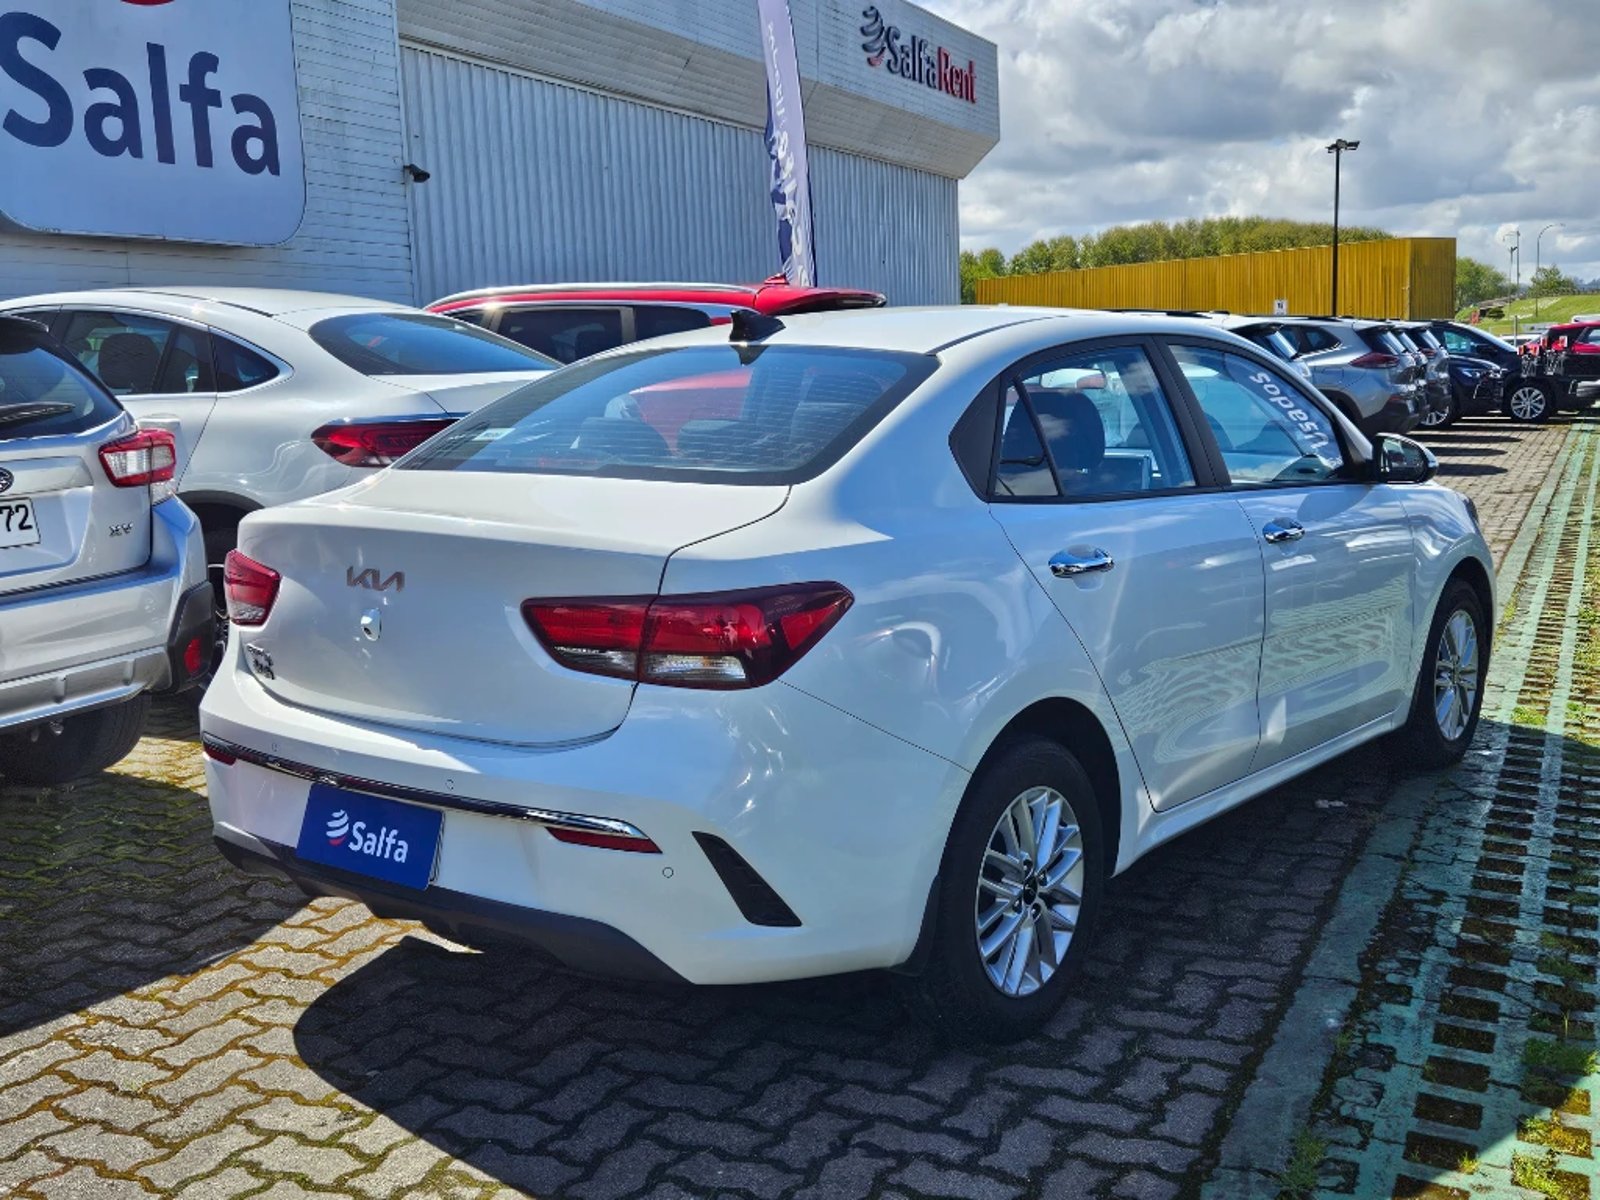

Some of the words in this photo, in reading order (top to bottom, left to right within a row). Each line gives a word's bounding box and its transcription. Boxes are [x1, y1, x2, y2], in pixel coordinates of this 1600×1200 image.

[886, 25, 977, 104] SalfaRent
[0, 11, 281, 177] Salfa
[1250, 371, 1329, 450] Usados
[0, 504, 33, 532] 72
[109, 522, 134, 537] XV
[346, 566, 405, 592] KIA
[348, 821, 409, 864] Salfa
